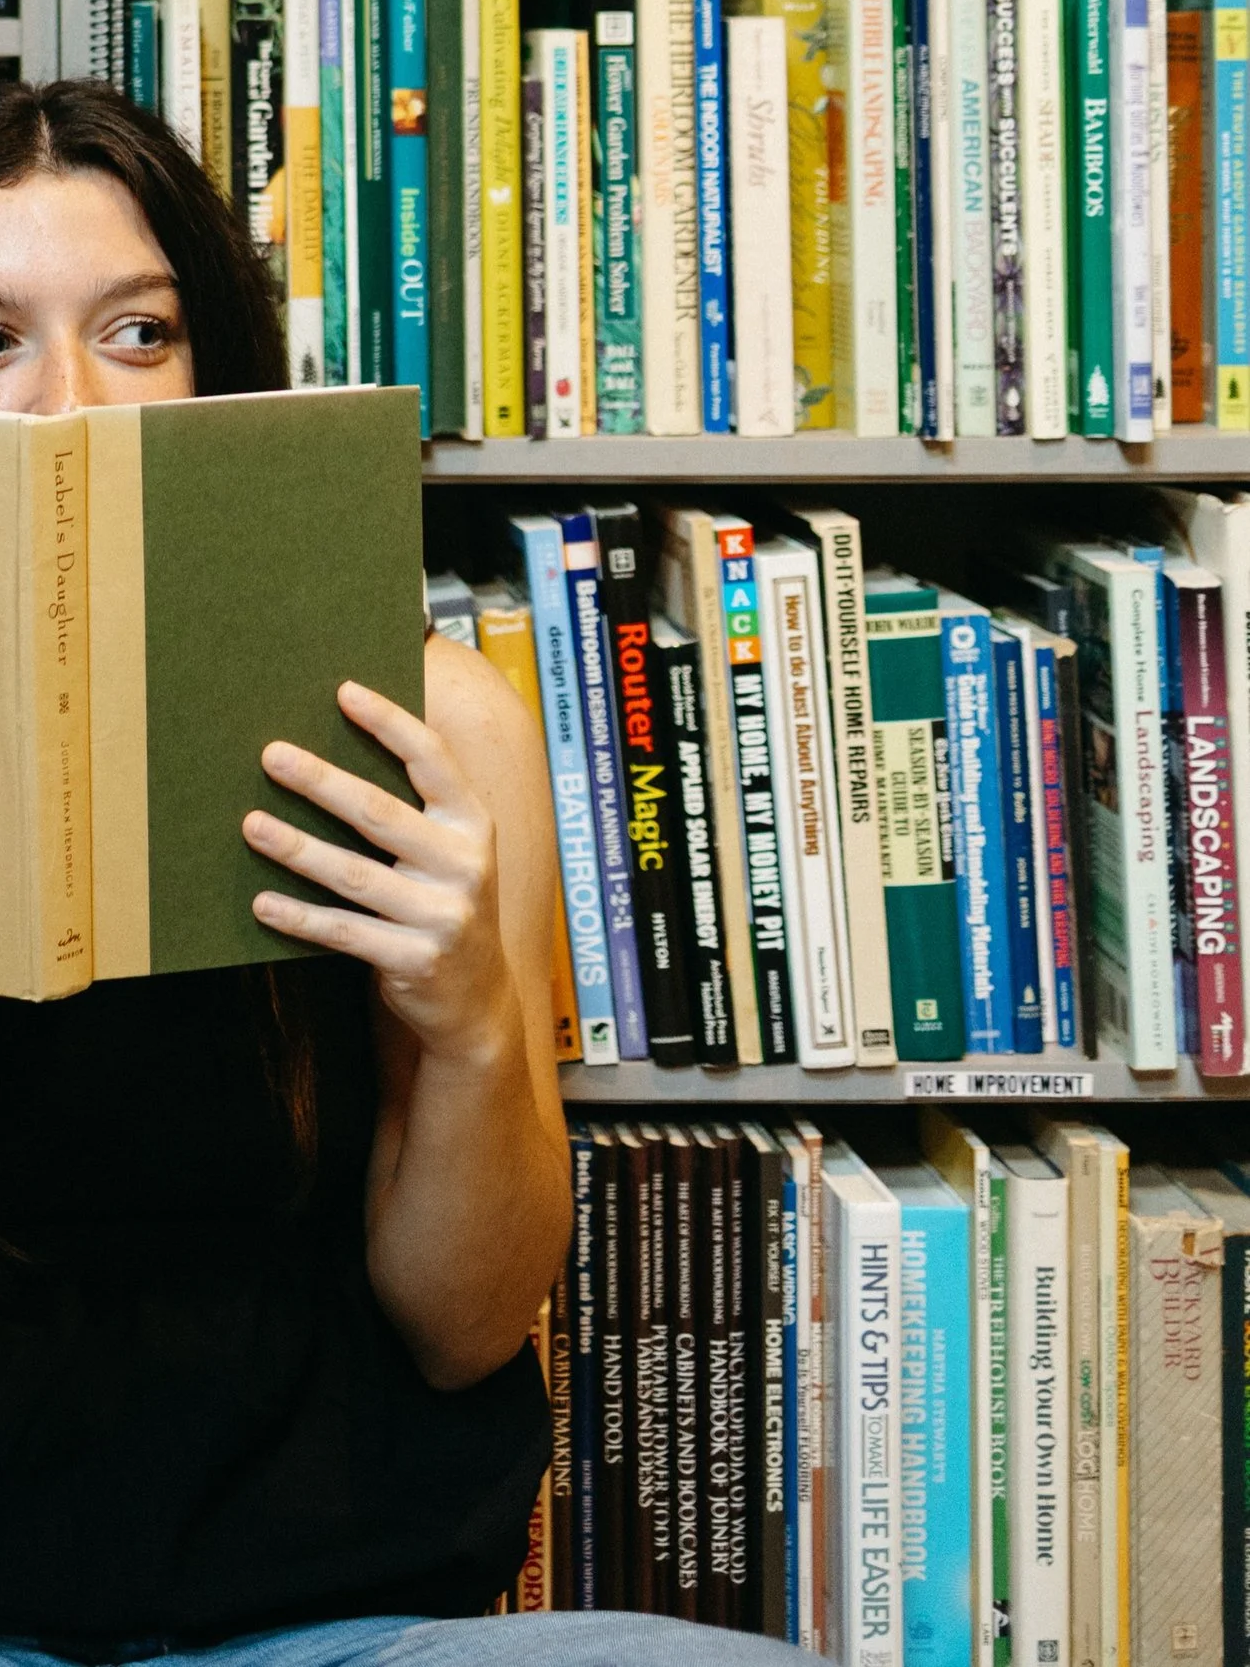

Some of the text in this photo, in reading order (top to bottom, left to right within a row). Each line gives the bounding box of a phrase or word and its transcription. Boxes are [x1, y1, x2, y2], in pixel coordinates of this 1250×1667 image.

[606, 55, 630, 315] Flower Garden Problem Solver
[961, 79, 982, 212] AMERICAN
[998, 118, 1017, 256] SUCCULENTS
[1083, 98, 1107, 217] BAMBOOS
[400, 186, 424, 326] Inside OUT
[48, 450, 75, 667] Isabel's Daughter
[575, 580, 604, 685] Bathroom
[735, 675, 764, 708] MY
[586, 687, 610, 747] DESIGN
[592, 750, 615, 784] AND
[784, 594, 821, 857] How to do Just About Anything
[843, 685, 865, 741] HOME
[1129, 589, 1159, 864] Complete Home Landscaping
[61, 741, 74, 899] JUDITH RYAN HENDRICKS
[547, 625, 608, 987] design ideas BATHROOMS
[597, 787, 623, 867] PLANNING
[617, 622, 671, 970] Router Magic HYLTON
[677, 740, 719, 949] APPLIED SOLAR ENERGY
[745, 792, 772, 828] MY
[848, 745, 871, 824] REPAIRS
[891, 770, 910, 837] GUIDE TO
[909, 727, 934, 878] SEASON-BY-SEASON
[1187, 715, 1227, 956] LANDSCAPING
[748, 833, 779, 909] MONEY
[755, 915, 784, 951] PIT
[913, 1075, 1084, 1094] HOME IMPROVEMENT
[575, 1150, 593, 1199] Decks,
[578, 1272, 593, 1303] and
[578, 1305, 593, 1354] Patios
[1149, 1258, 1183, 1369] BUILDER
[552, 1334, 571, 1497] CABINETMAKING
[603, 1334, 622, 1464] HAND TOOLS
[709, 1339, 729, 1457] HANDBOOK
[764, 1319, 784, 1513] HOME ELECTRONICS
[900, 1230, 926, 1582] HOMEKEEPING HANDBOOK
[932, 1328, 944, 1395] MARTHA
[1029, 1266, 1057, 1567] Building Your Own Home
[675, 1333, 698, 1589] CABINETS AND BOOKCASES
[860, 1244, 890, 1640] HINTS & TIPS TO MAKE LIFE EASIER
[709, 1495, 729, 1576] JOINERY
